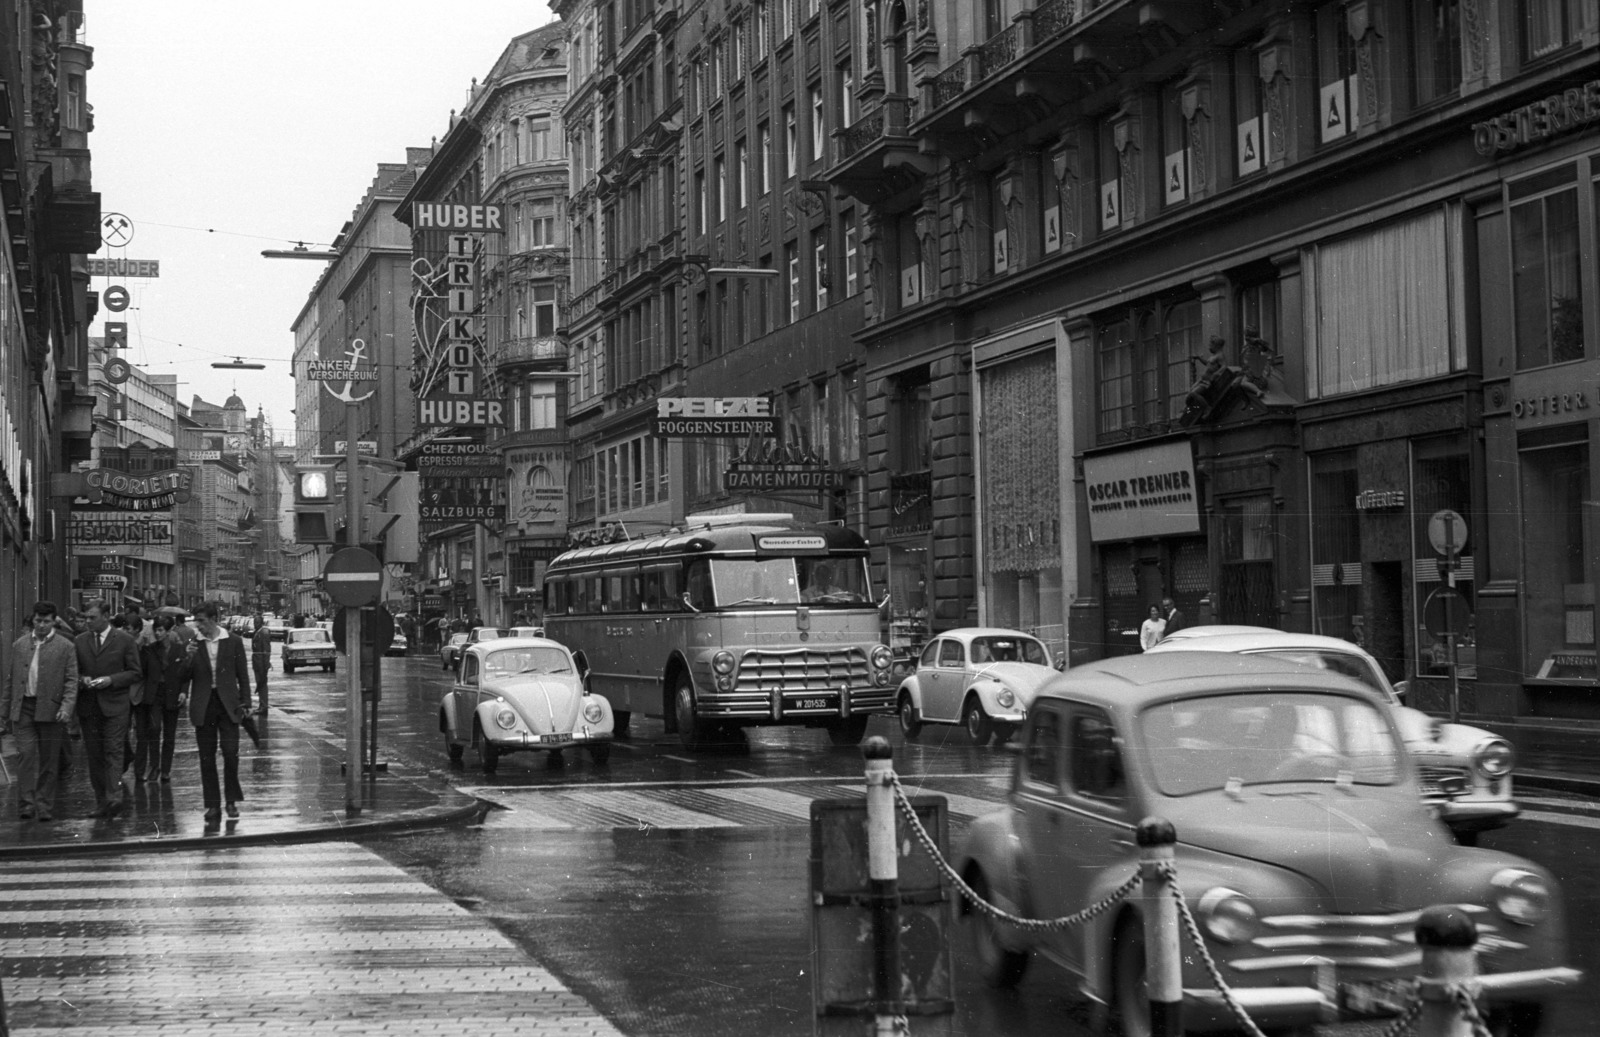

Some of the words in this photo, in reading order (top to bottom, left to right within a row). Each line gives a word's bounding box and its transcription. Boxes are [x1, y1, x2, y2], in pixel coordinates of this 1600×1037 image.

[418, 204, 502, 229] HUBER
[88, 259, 159, 276] EBRÜDER
[453, 236, 470, 393] TRIKOT
[308, 360, 351, 370] ANKER
[309, 371, 378, 380] VERSICHERUNG
[420, 400, 504, 425] HUBER
[657, 421, 774, 434] FOGGENSTEINER
[422, 444, 455, 454] CHEZ
[457, 444, 492, 454] NOUS
[419, 456, 463, 466] ESPRESSO
[87, 471, 191, 494] GLORIETTE
[728, 473, 844, 487] DAMENMODEN
[1089, 480, 1128, 502] OSCAR
[1129, 470, 1190, 496] TRENNER
[422, 506, 495, 518] SALZBURG
[83, 525, 166, 540] BANK
[795, 699, 803, 709] W
